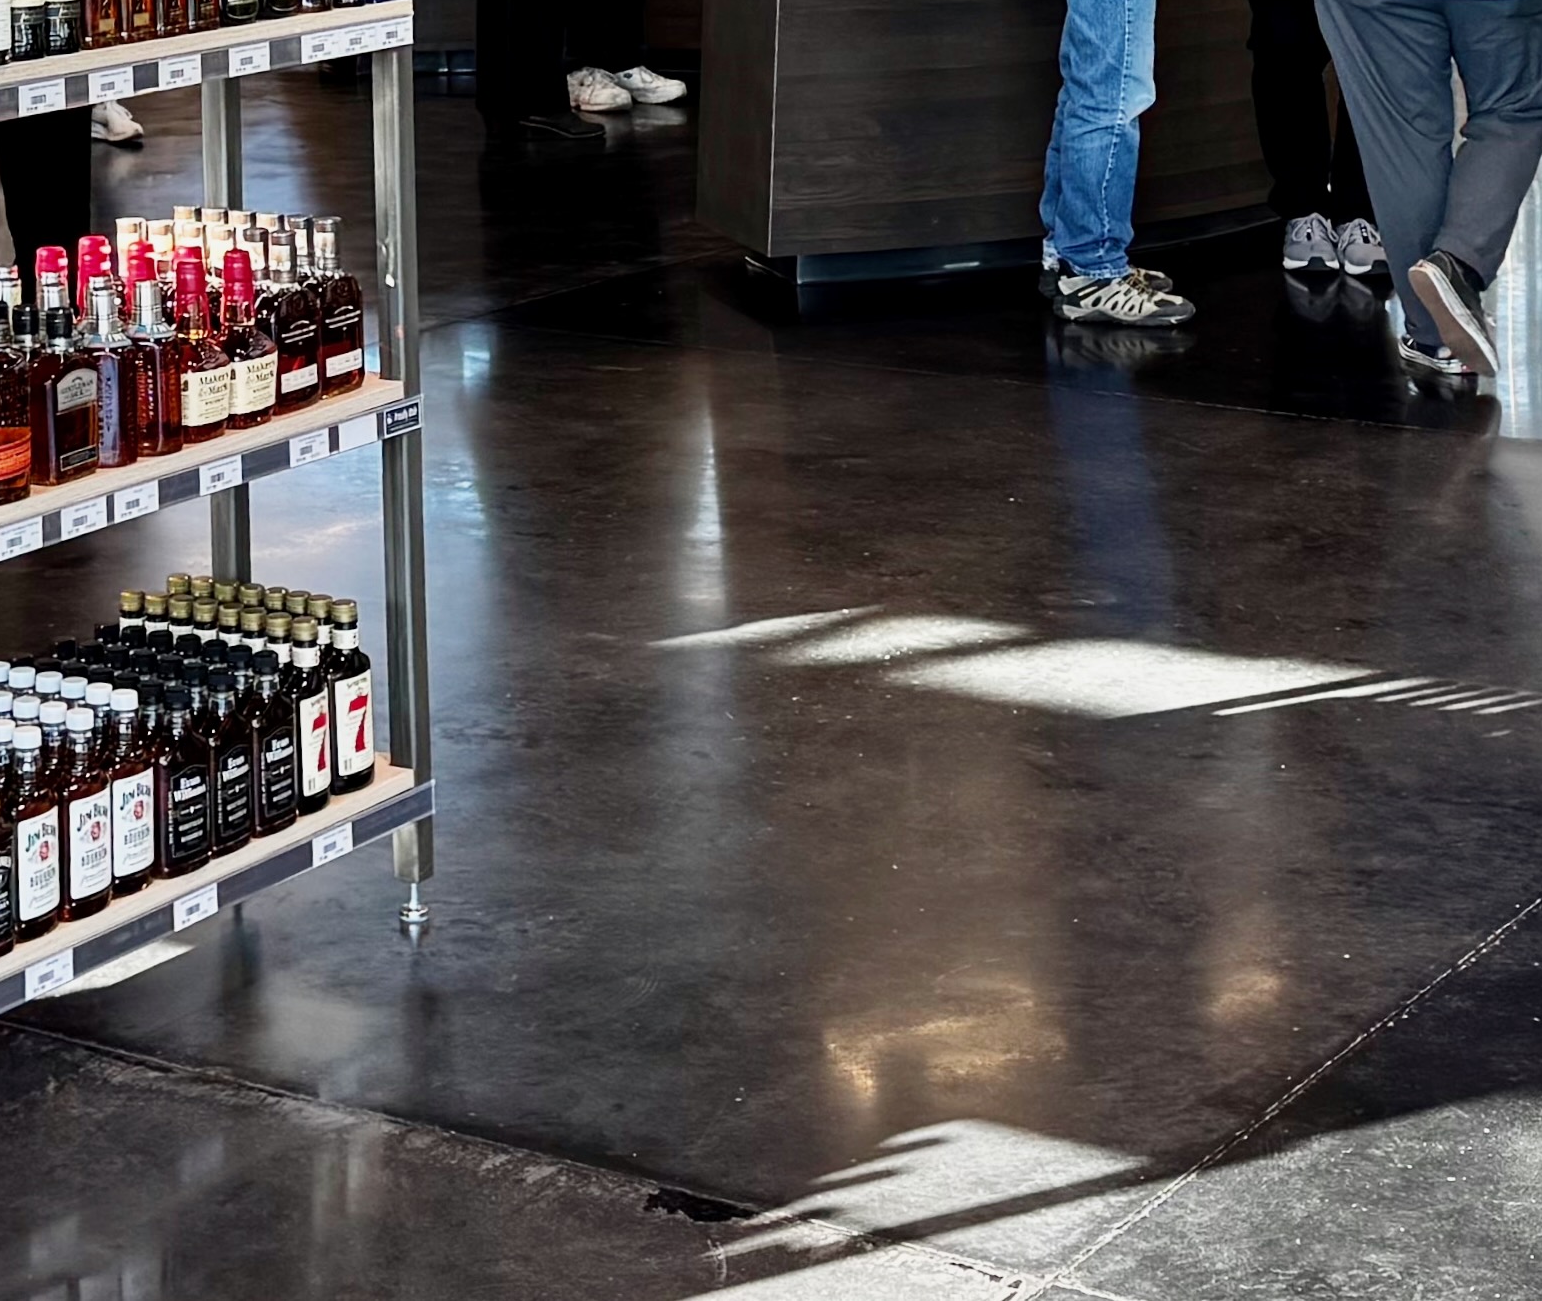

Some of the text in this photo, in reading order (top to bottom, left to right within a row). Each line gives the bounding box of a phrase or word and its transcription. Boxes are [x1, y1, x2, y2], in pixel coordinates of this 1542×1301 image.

[208, 382, 228, 395] Mark
[255, 370, 275, 384] Mark
[348, 693, 369, 753] 7
[312, 712, 327, 773] 7
[120, 789, 135, 811] JIM
[77, 809, 92, 832] JIM
[25, 830, 41, 853] JIM
